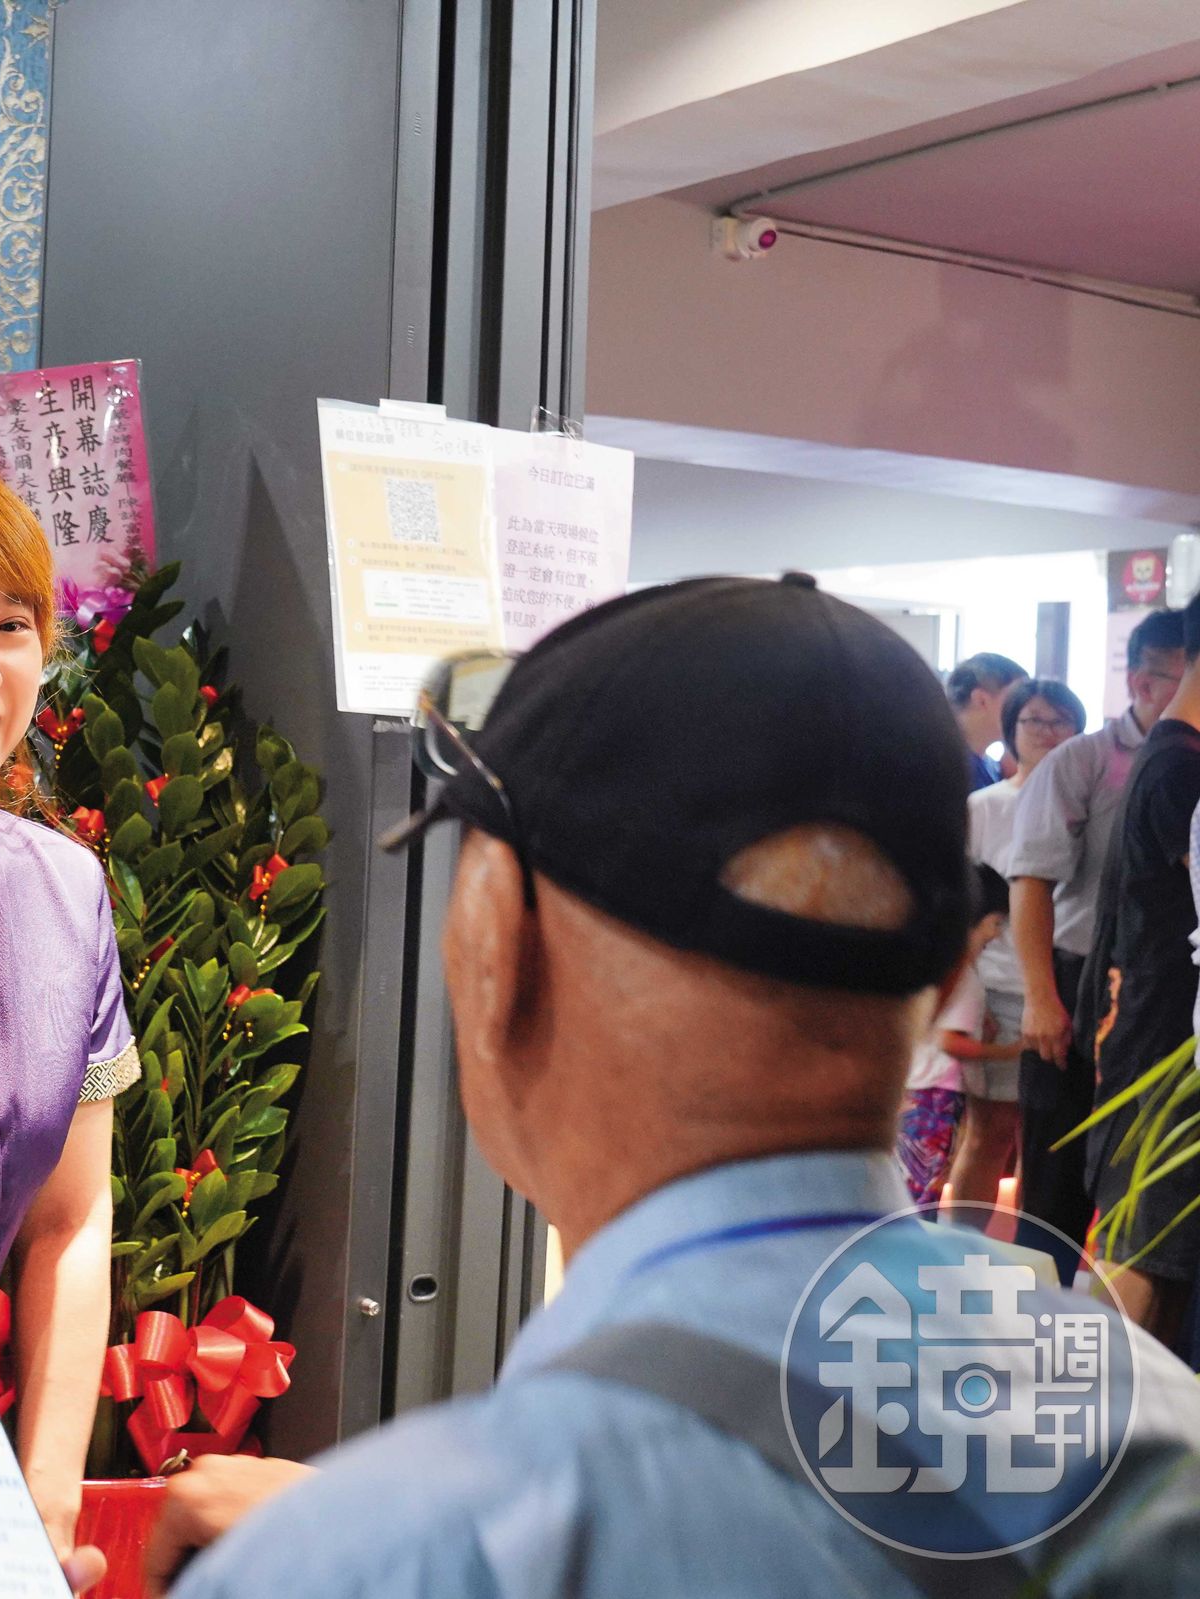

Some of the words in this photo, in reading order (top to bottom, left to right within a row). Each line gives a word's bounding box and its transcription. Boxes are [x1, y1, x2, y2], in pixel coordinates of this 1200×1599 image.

[38, 380, 81, 547] 生意興隆
[70, 375, 115, 545] 開幕誌慶
